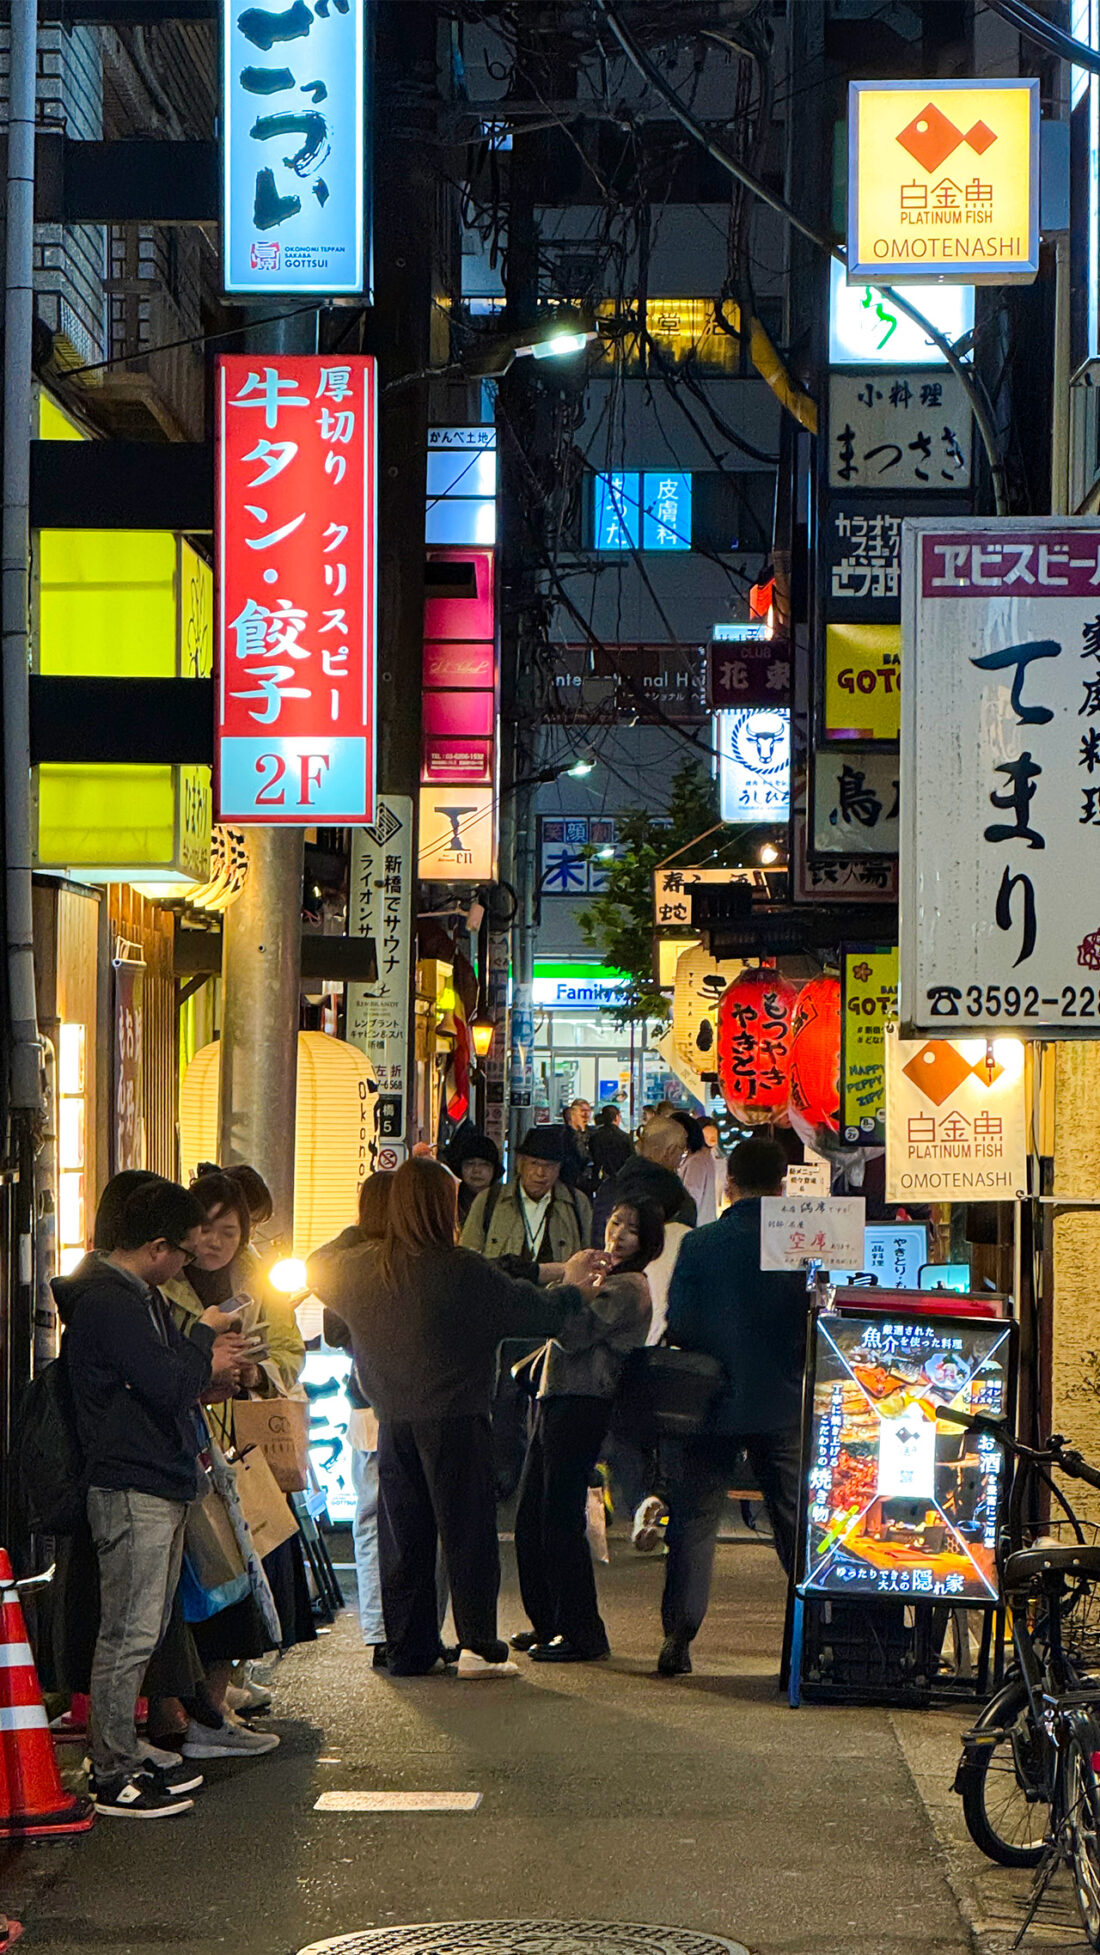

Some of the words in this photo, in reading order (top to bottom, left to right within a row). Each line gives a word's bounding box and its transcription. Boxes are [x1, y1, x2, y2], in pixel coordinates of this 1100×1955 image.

[900, 211, 962, 224] PLATINUM
[965, 210, 993, 224] FISH
[284, 259, 328, 268] GOTTSUI
[873, 237, 1021, 258] OMOTENASHI
[858, 380, 943, 409] 小料理
[315, 366, 356, 486] 厚切り
[429, 431, 489, 444] かんべ土地
[656, 477, 679, 545] 皮膚科
[834, 511, 902, 537] カラオケ
[228, 366, 312, 725] 牛タン・餃子
[317, 522, 350, 722] クリスピー
[883, 653, 901, 665] BA
[254, 753, 331, 806] 2F
[969, 639, 1063, 969] てまり
[383, 854, 402, 975] 新橋でサウナ
[966, 985, 1100, 1018] 3592-22
[731, 1002, 759, 1100] やきとり
[760, 992, 788, 1090] もつやき
[907, 1144, 972, 1159] PLATINUM
[974, 1143, 1003, 1158] FISH
[900, 1171, 1013, 1189] OMOTENASHI
